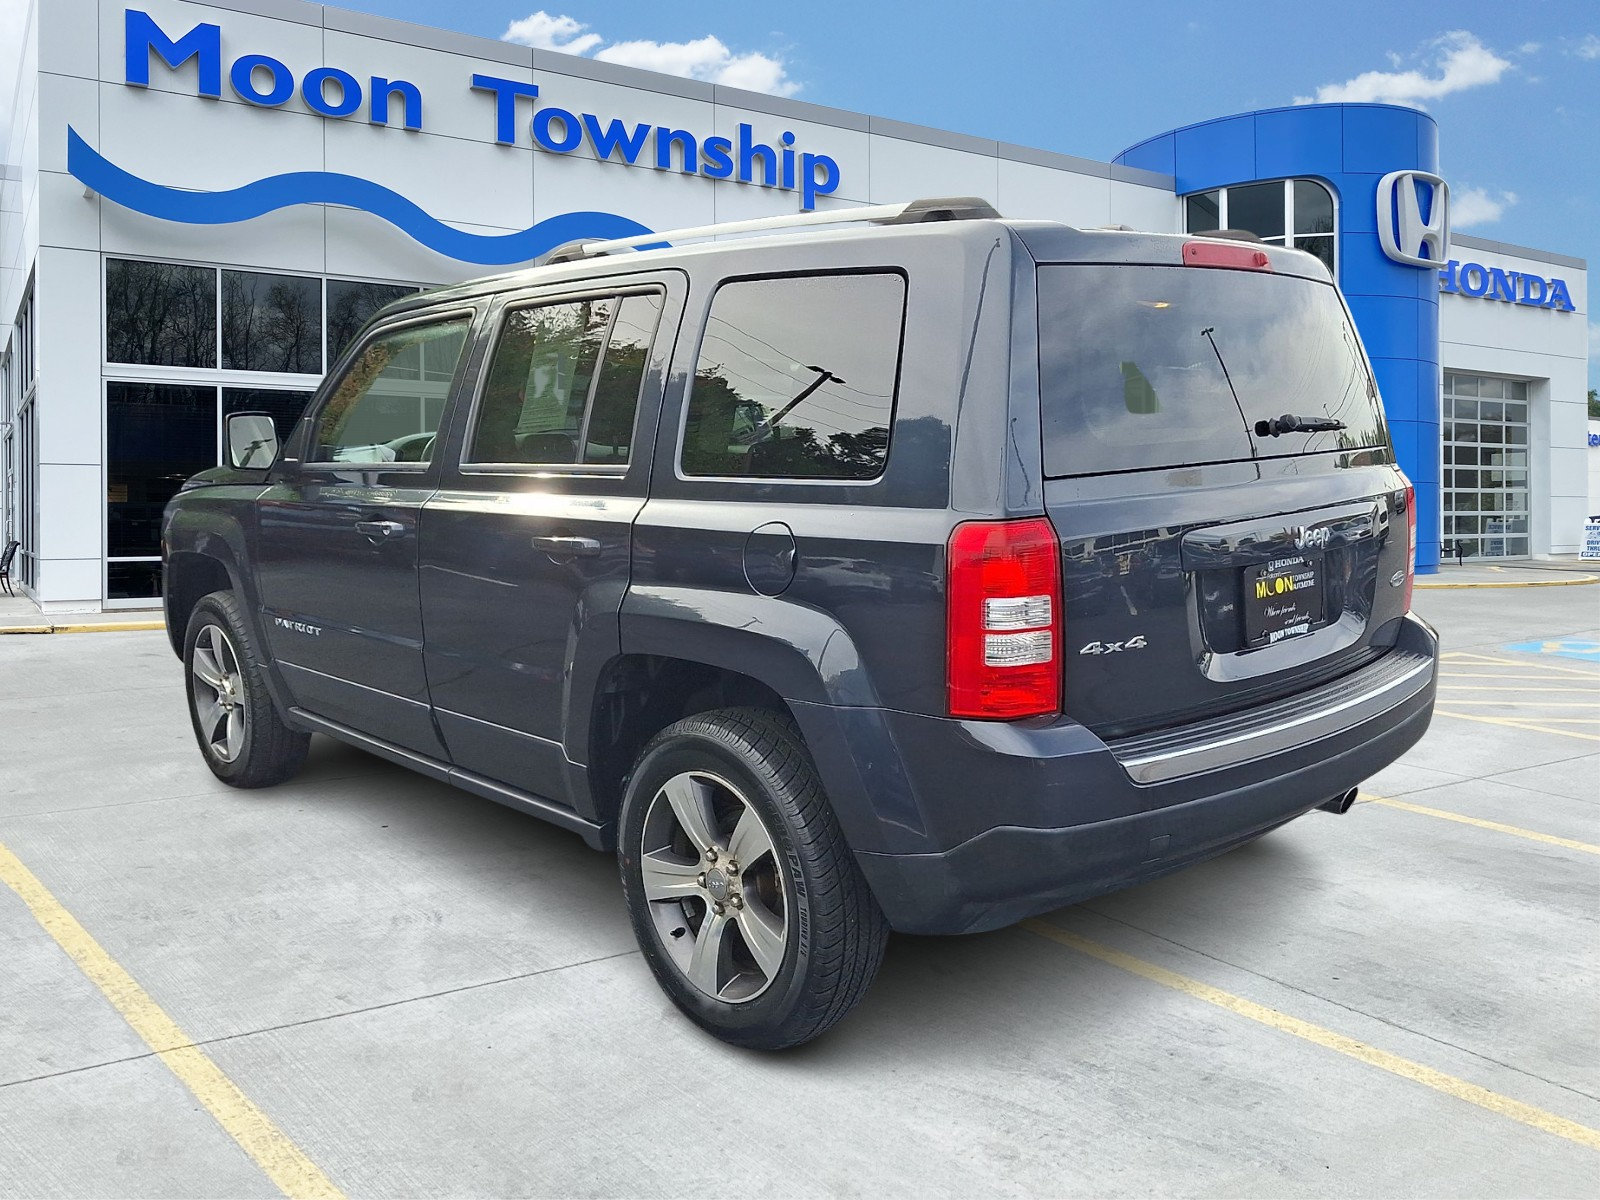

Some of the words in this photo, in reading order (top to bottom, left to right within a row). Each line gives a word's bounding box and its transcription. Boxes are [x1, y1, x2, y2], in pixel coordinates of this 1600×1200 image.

[125, 8, 422, 131] Moon
[469, 73, 841, 213] Township
[1439, 259, 1576, 312] HONDA
[1294, 525, 1330, 550] Jeep
[1275, 556, 1304, 568] HONDA
[274, 617, 322, 636] PATRIOT
[1079, 635, 1148, 655] 4x4
